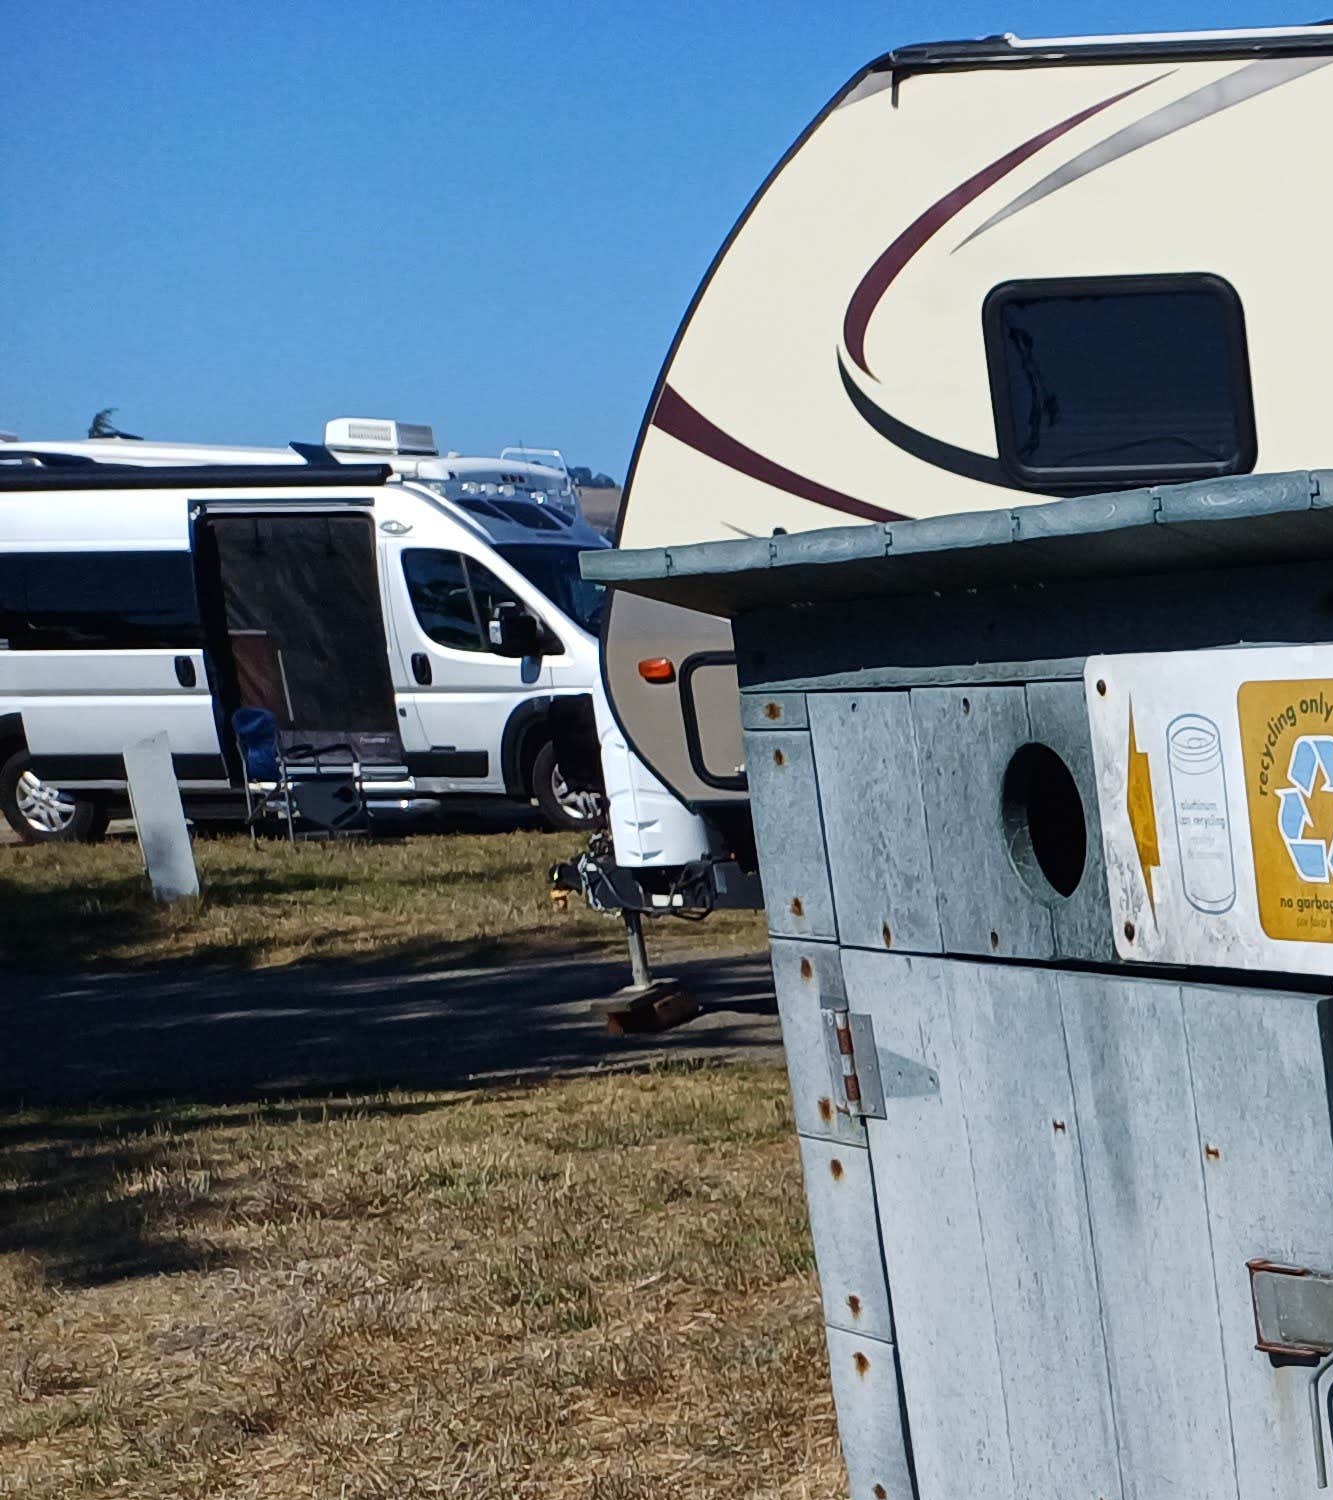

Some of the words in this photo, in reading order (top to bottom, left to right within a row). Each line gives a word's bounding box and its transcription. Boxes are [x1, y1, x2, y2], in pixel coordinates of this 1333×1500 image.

[1259, 705, 1297, 796] recycling
[1300, 691, 1333, 722] only
[1280, 897, 1293, 908] no
